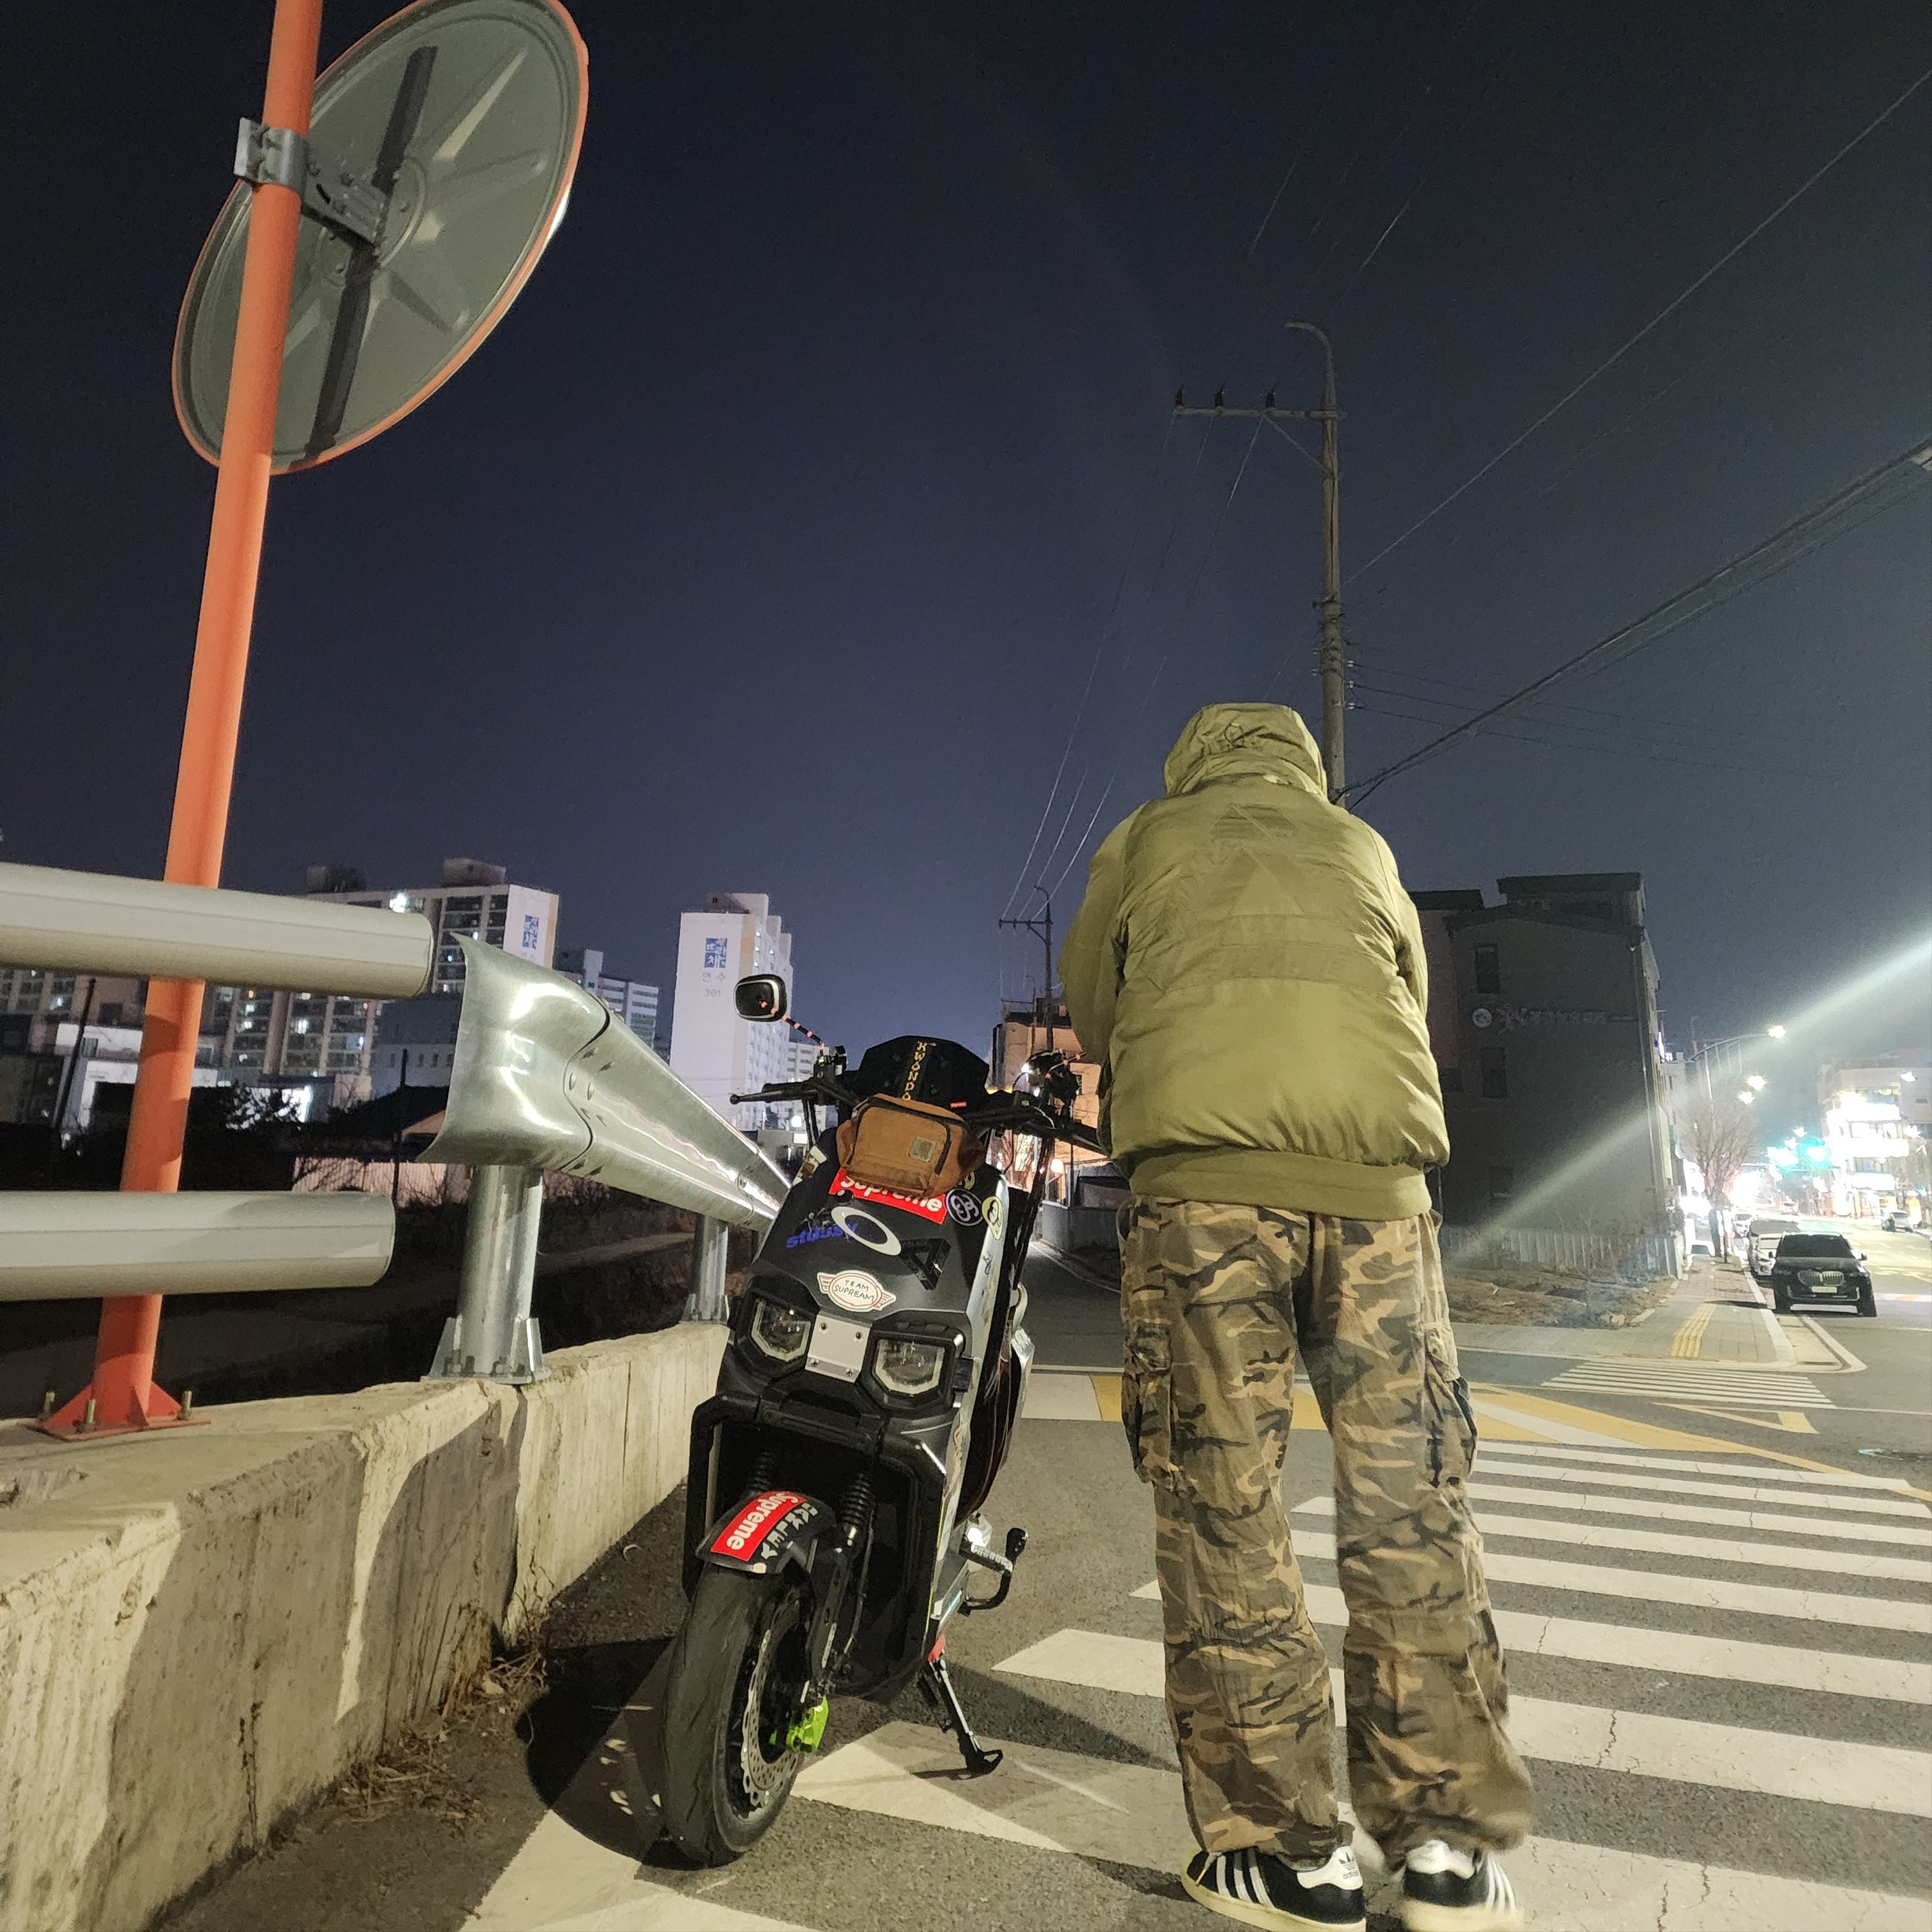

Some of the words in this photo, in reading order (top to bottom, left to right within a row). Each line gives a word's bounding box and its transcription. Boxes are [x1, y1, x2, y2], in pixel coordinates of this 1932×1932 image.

[704, 988, 721, 997] 301
[834, 1285, 875, 1303] SUPREAM
[844, 1280, 869, 1292] TEAM
[726, 1492, 799, 1551] Supreme
[760, 1502, 819, 1560] OAKLEY
